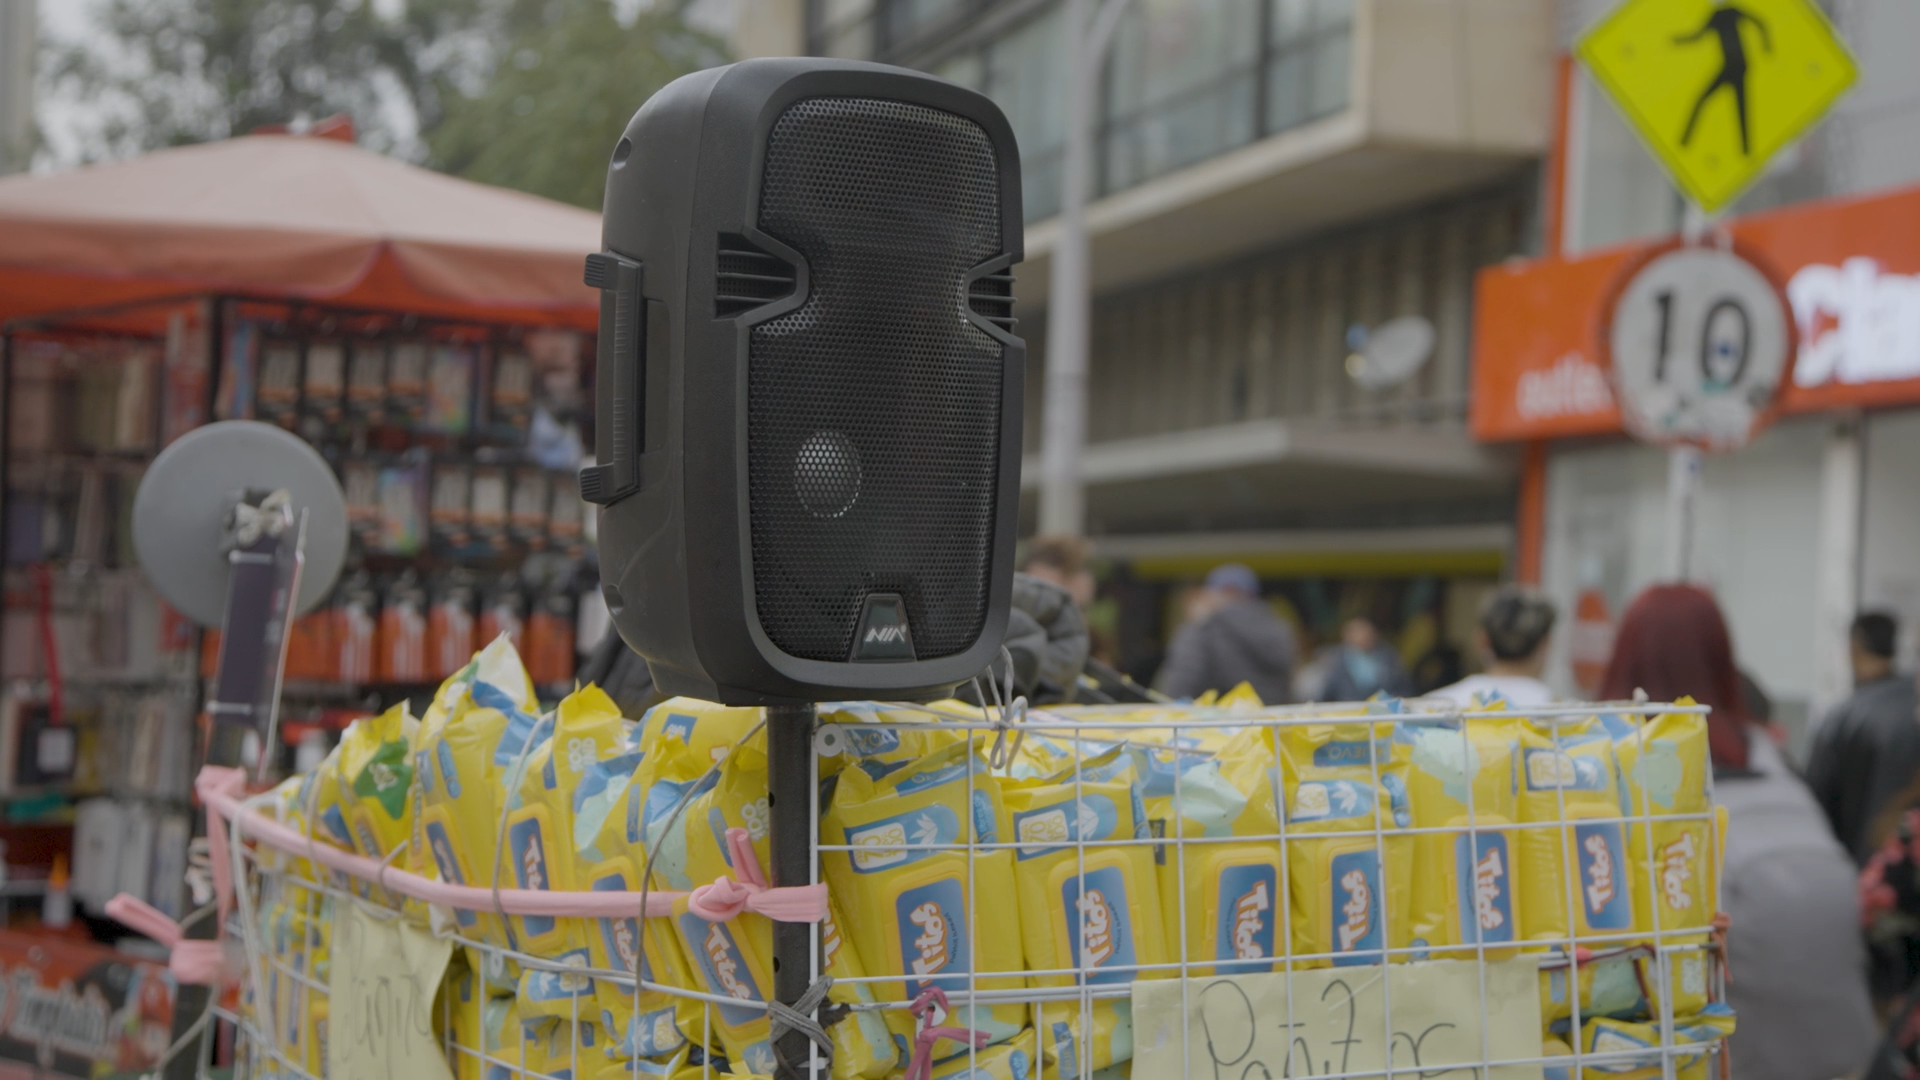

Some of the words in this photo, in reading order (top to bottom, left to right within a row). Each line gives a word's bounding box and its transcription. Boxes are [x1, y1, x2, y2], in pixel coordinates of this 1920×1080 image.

[1655, 287, 1753, 386] 10
[1516, 350, 1614, 420] outle
[523, 833, 542, 890] Tit
[1475, 847, 1503, 930] Titos
[1584, 834, 1614, 914] Titos
[1661, 829, 1695, 910] Titos
[612, 917, 638, 975] itos
[910, 901, 949, 988] Titos
[1075, 889, 1114, 979] Titos
[1233, 880, 1269, 960] Titos
[1337, 869, 1370, 953] Titos
[703, 921, 751, 1000] Titos
